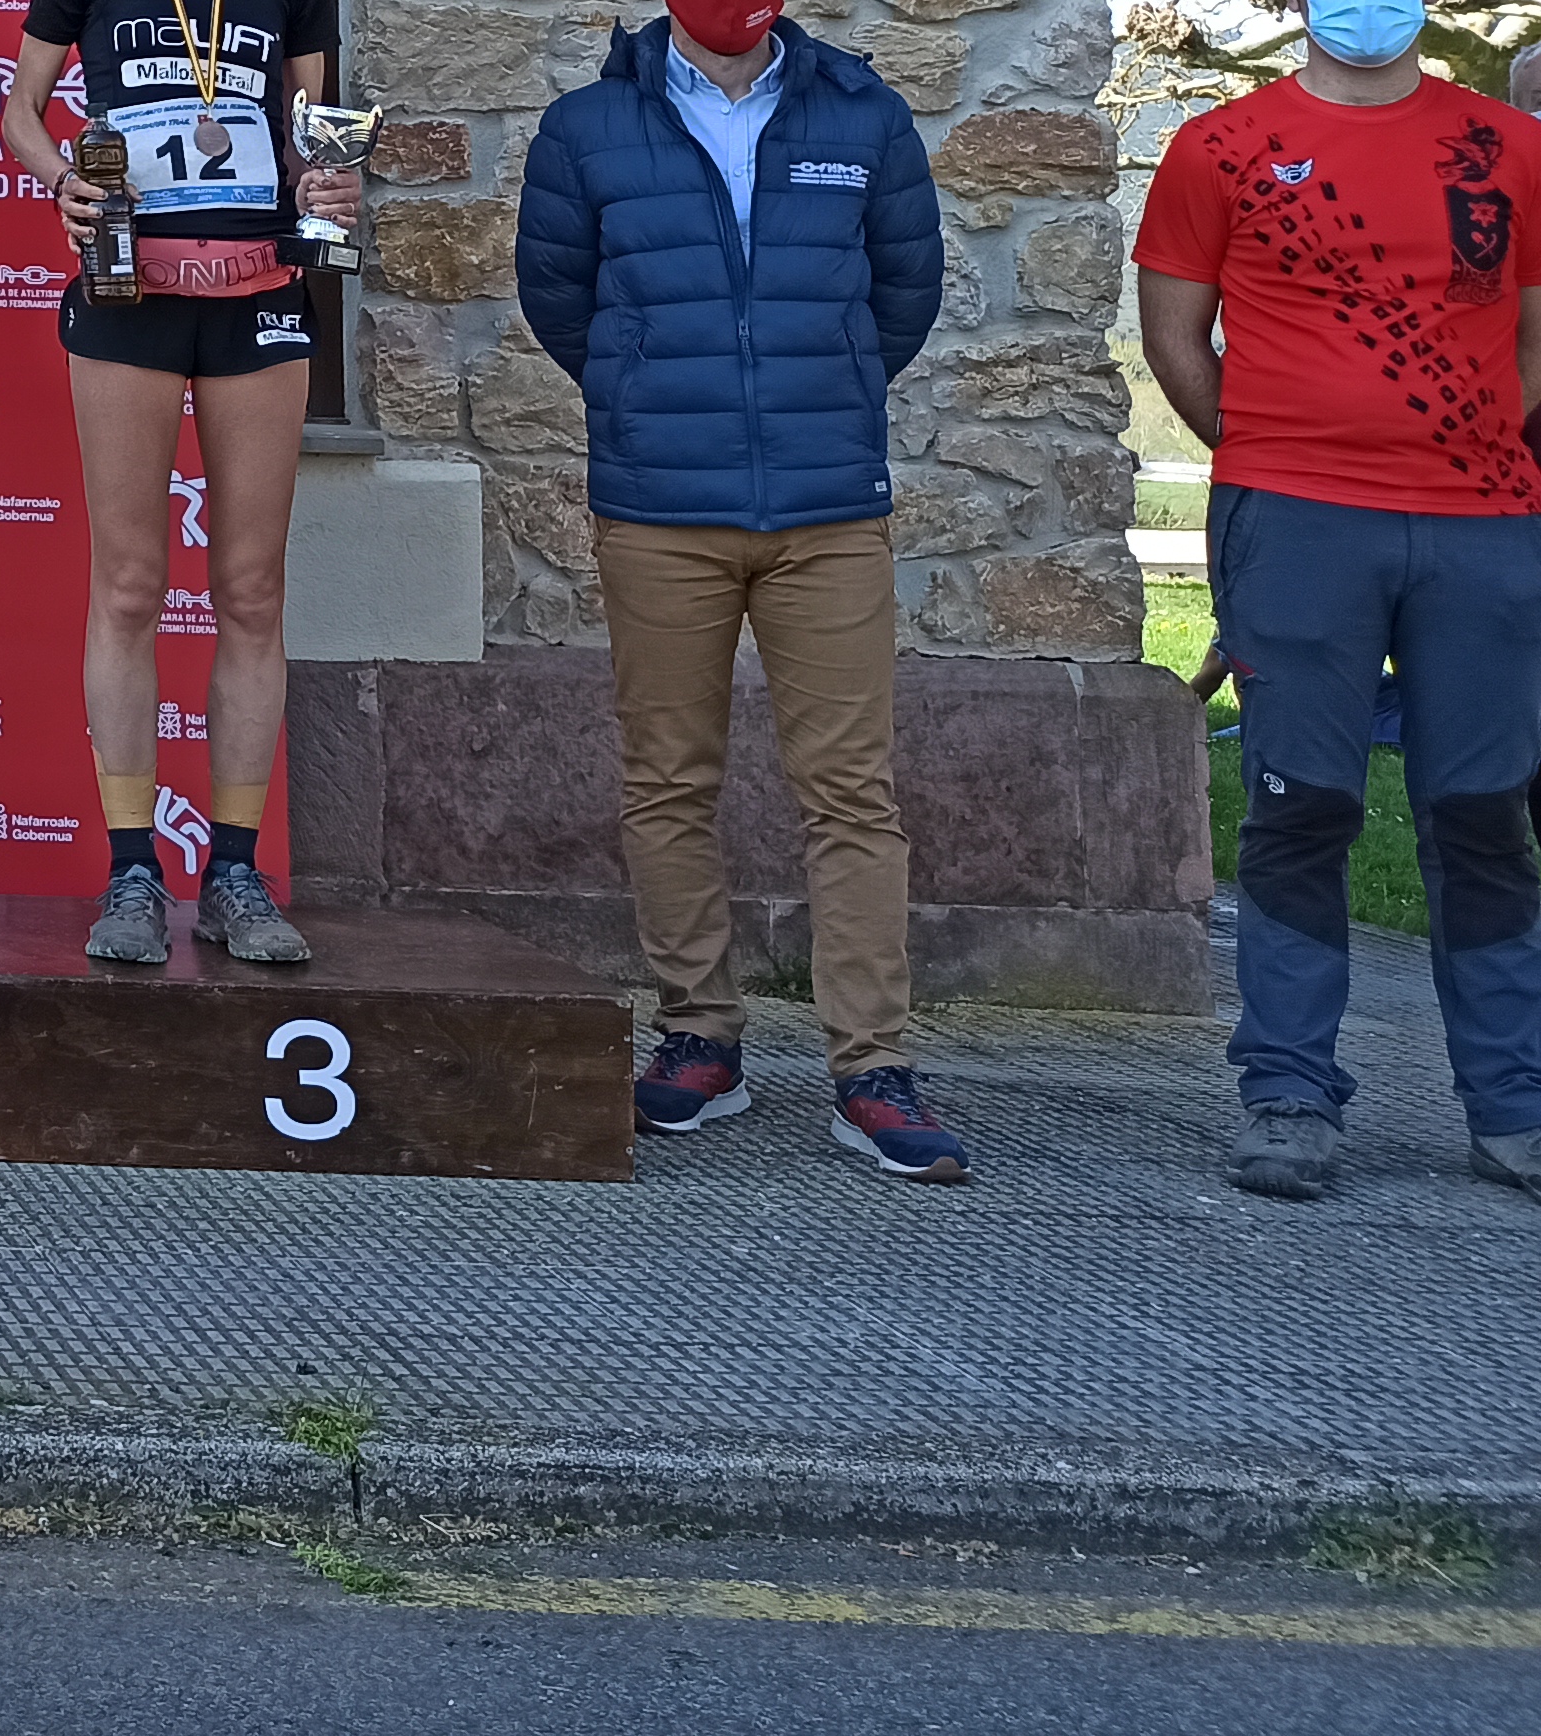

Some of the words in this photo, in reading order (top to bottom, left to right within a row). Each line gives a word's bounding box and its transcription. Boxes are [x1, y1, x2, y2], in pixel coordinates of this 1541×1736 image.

[156, 134, 237, 181] 12
[9, 300, 61, 309] FEDERAKUNTZ
[160, 613, 184, 622] ARRA
[12, 815, 79, 828] Nafarroako
[13, 829, 72, 841] Gobernua
[264, 1019, 356, 1141] 3
